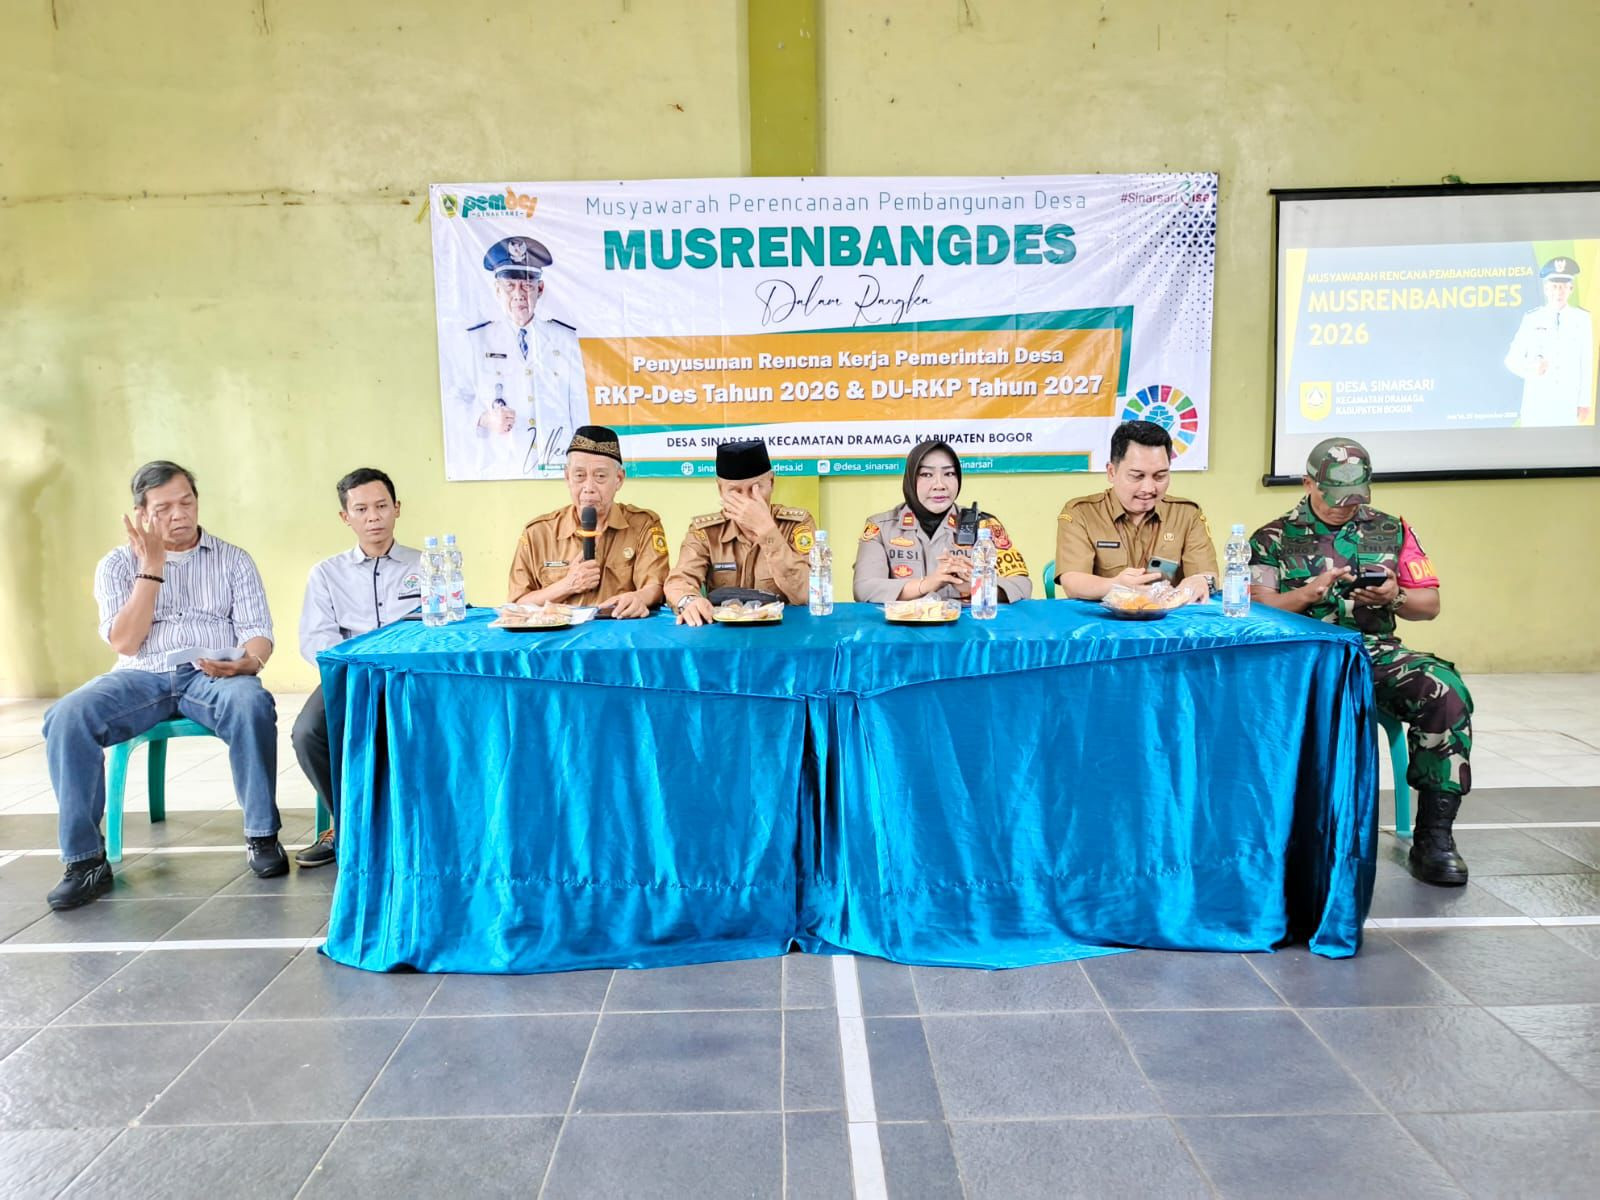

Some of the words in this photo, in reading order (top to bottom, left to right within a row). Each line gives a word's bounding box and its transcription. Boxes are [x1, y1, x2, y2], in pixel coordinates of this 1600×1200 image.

[586, 194, 719, 220] Musyawarah
[729, 193, 869, 212] Perencanaan
[879, 191, 1025, 215] Pembangunan
[1035, 190, 1086, 209] Desa
[603, 223, 1077, 270] MUSRENBANGDES
[1307, 271, 1378, 283] MUSYAWARAH
[1379, 269, 1428, 281] RENCANA
[1428, 267, 1507, 279] PEMBANGUNAN
[1507, 266, 1533, 277] DESA
[853, 274, 932, 327] Rangka
[1307, 284, 1522, 313] MUSRENBANGDES
[1308, 323, 1369, 346] 2026
[633, 355, 752, 374] Penyusunan
[758, 352, 833, 369] Rencna
[838, 350, 889, 370] Kerja
[895, 347, 1009, 367] Pemerintah
[1015, 348, 1064, 364] Desa
[594, 385, 697, 405] RKP-Des
[702, 383, 774, 403] Tahun
[780, 381, 840, 401] 2026
[846, 380, 865, 400] &
[871, 378, 963, 399] DU-RKP
[967, 377, 1038, 397] Tahun
[1044, 374, 1104, 395] 2027
[1336, 380, 1368, 393] DESA
[1370, 378, 1434, 392] SINARSARI
[667, 437, 697, 447] DESA
[768, 434, 845, 446] KECAMATAN
[847, 434, 911, 445] DRAMAGA
[915, 433, 985, 445] KABUPATEN
[989, 432, 1033, 443] BOGOR
[889, 549, 919, 560] DESI
